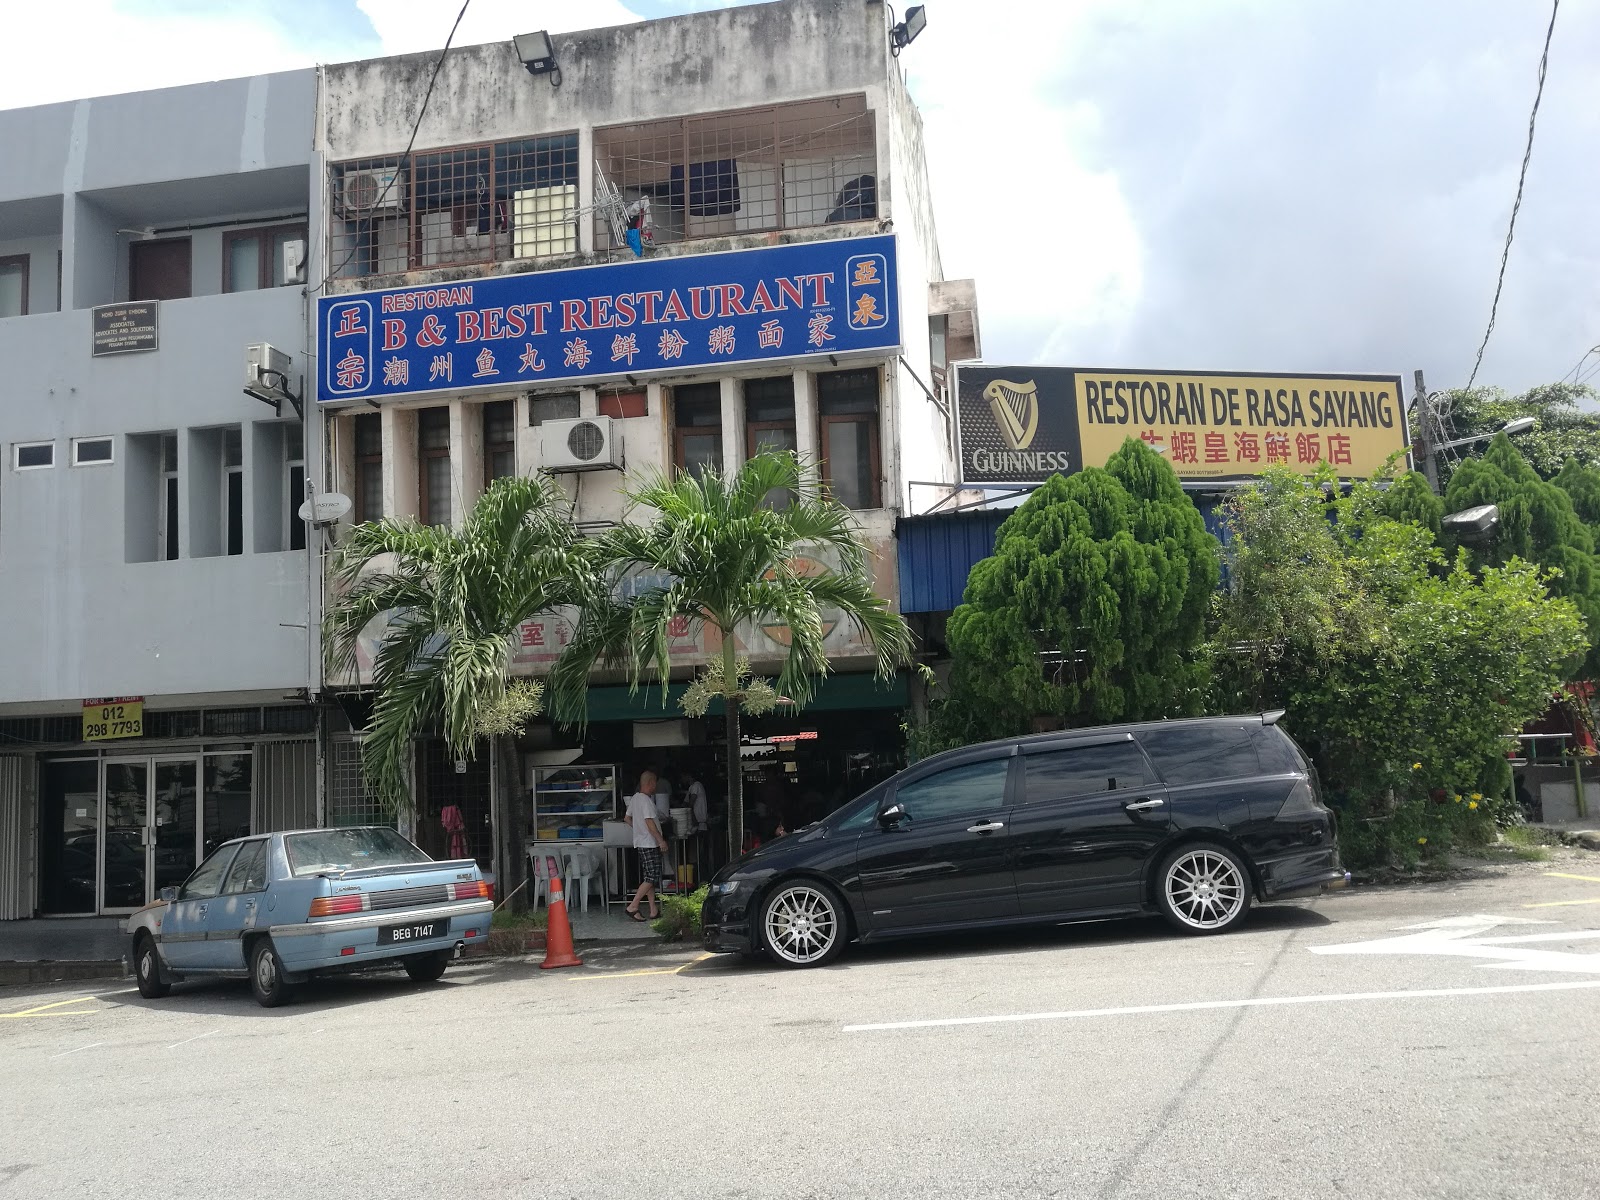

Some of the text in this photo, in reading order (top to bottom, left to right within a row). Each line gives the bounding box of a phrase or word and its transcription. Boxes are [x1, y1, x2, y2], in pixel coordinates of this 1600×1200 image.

[382, 286, 473, 314] RESTORAN
[852, 260, 884, 326] 亞泉
[382, 272, 834, 351] B & BEST RESTAURANT
[95, 329, 118, 337] ADVOCATES
[335, 306, 367, 388] 正宗
[1085, 380, 1393, 429] RESTORAN DE RASA SAYANG
[972, 449, 1069, 472] GUINNESS
[102, 706, 124, 720] 012
[86, 720, 141, 737] 298 7793
[393, 925, 434, 941] BEG 7147
